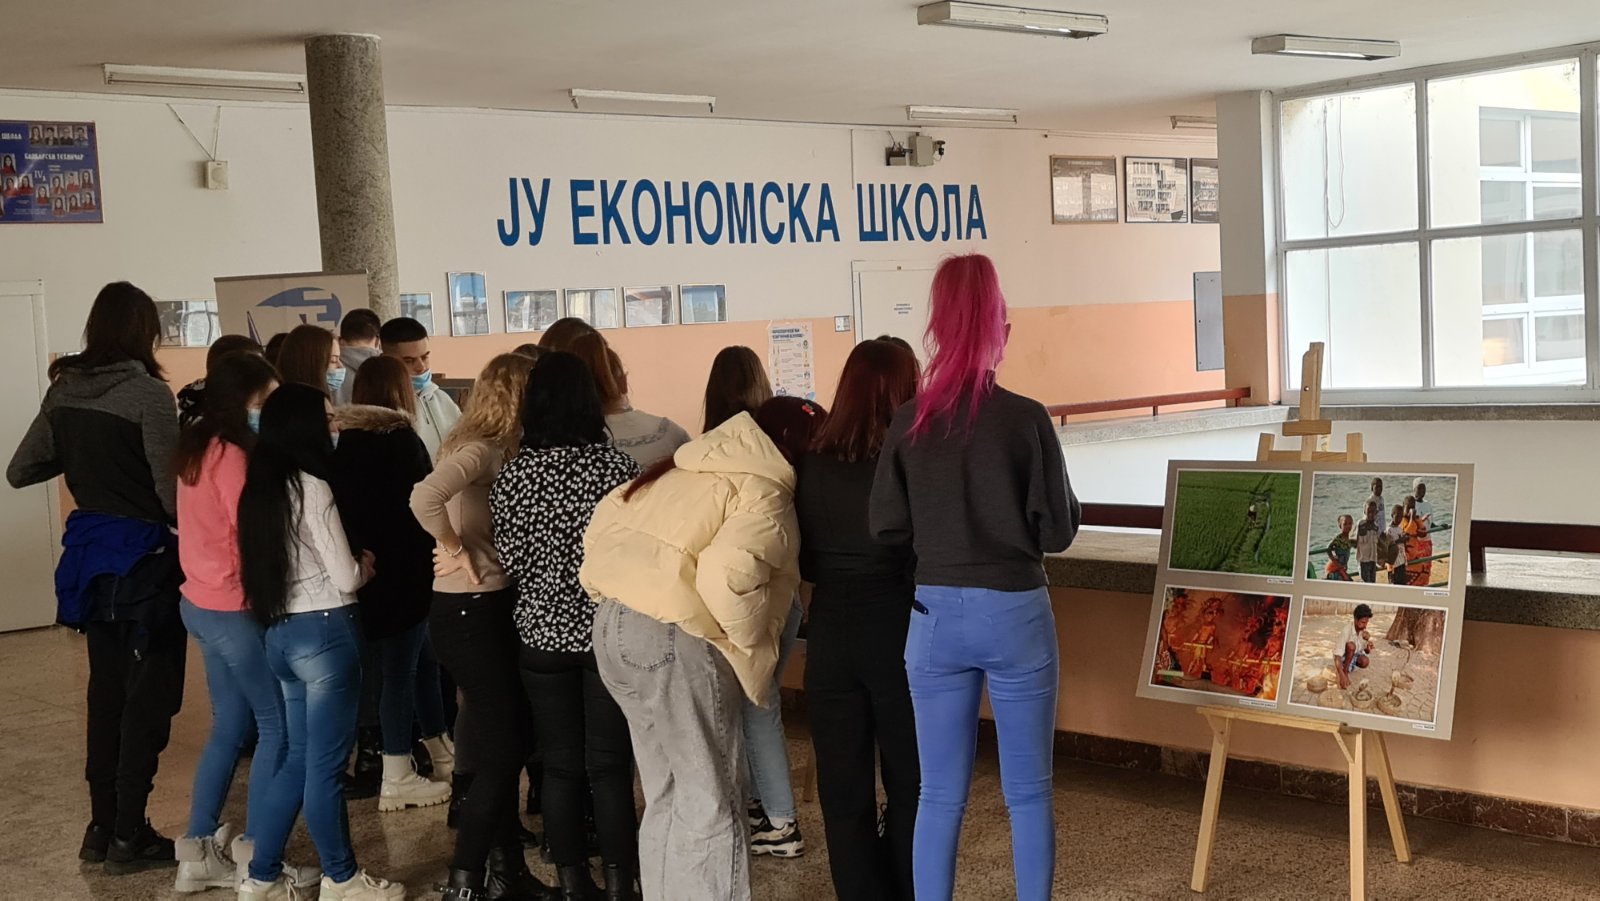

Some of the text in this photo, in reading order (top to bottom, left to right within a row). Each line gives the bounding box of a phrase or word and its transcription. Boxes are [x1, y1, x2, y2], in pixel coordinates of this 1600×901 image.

[497, 177, 988, 246] ЈУ ЕКОНОМСКА ШКОЛА
